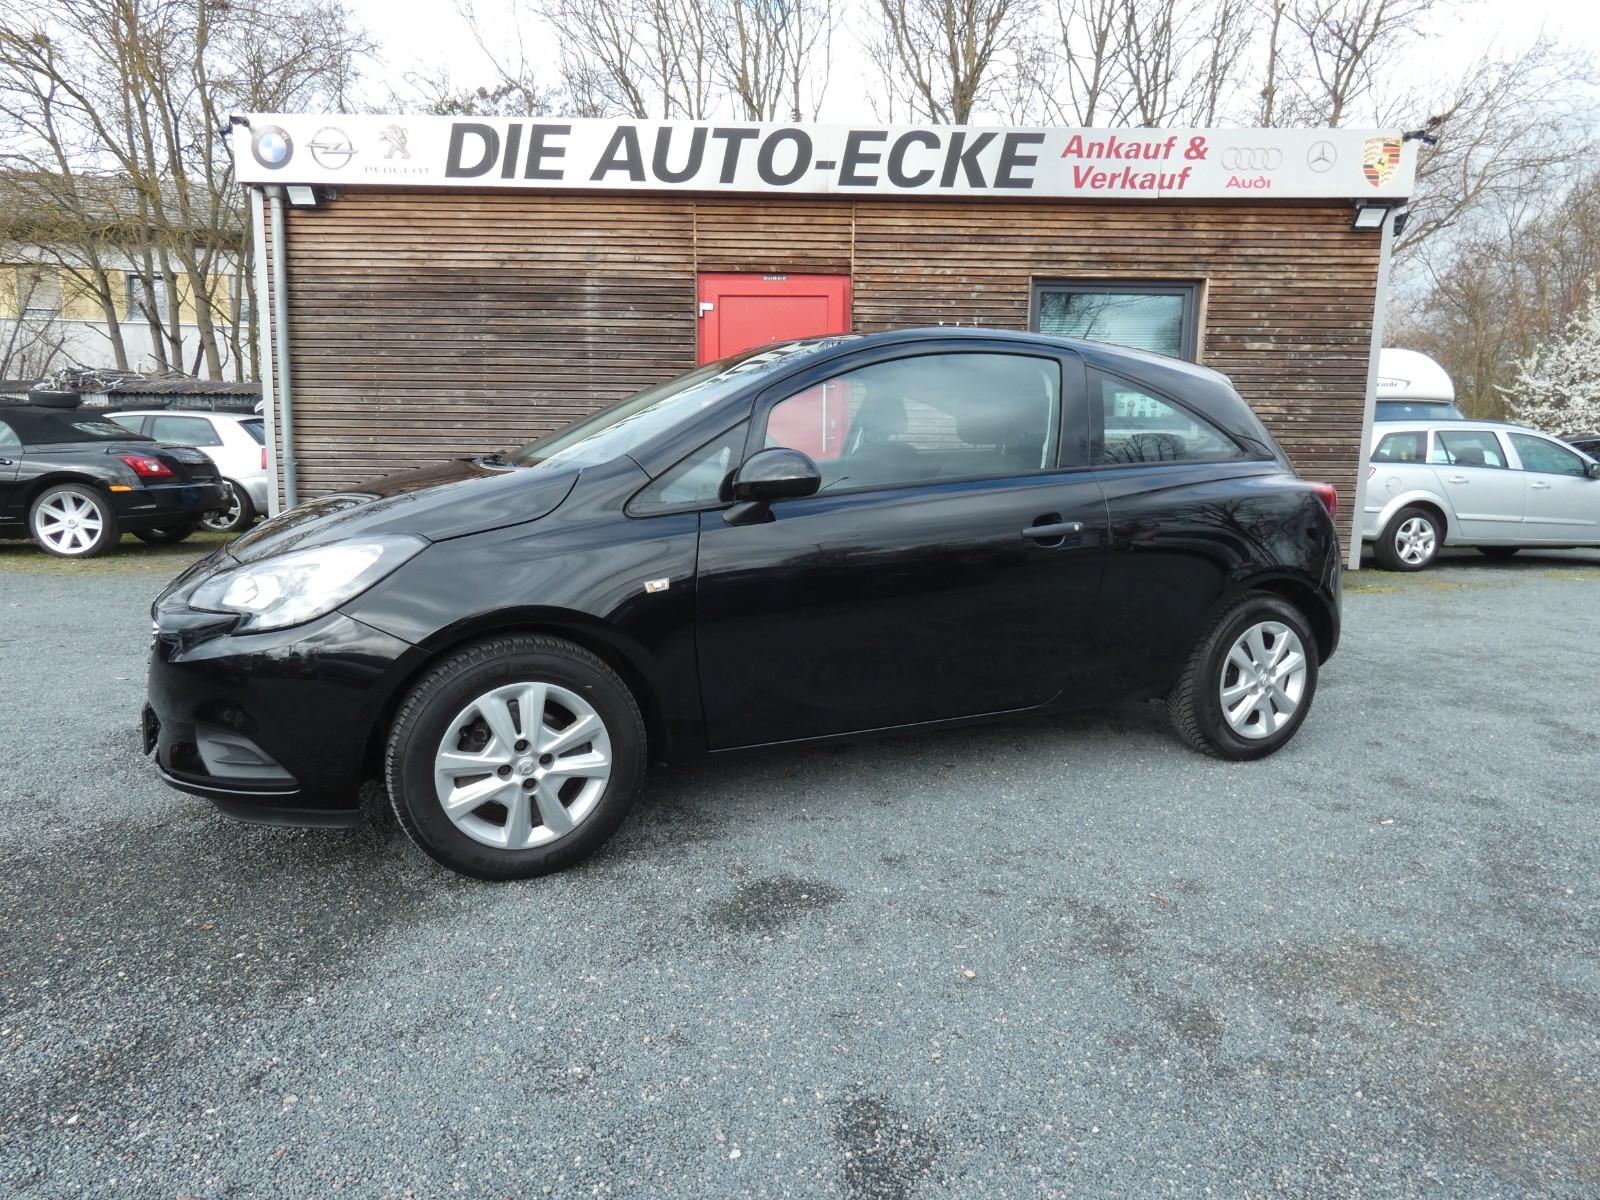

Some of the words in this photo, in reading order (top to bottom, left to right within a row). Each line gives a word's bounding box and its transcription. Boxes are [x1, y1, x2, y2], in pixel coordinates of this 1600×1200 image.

[445, 122, 572, 180] DIE
[589, 125, 1046, 189] AUTO-ECKE
[1061, 135, 1177, 160] Ankauf
[1184, 136, 1209, 161] &
[364, 165, 430, 175] PEUGEOT
[1073, 166, 1192, 190] Verkauf
[1225, 175, 1271, 189] Audi
